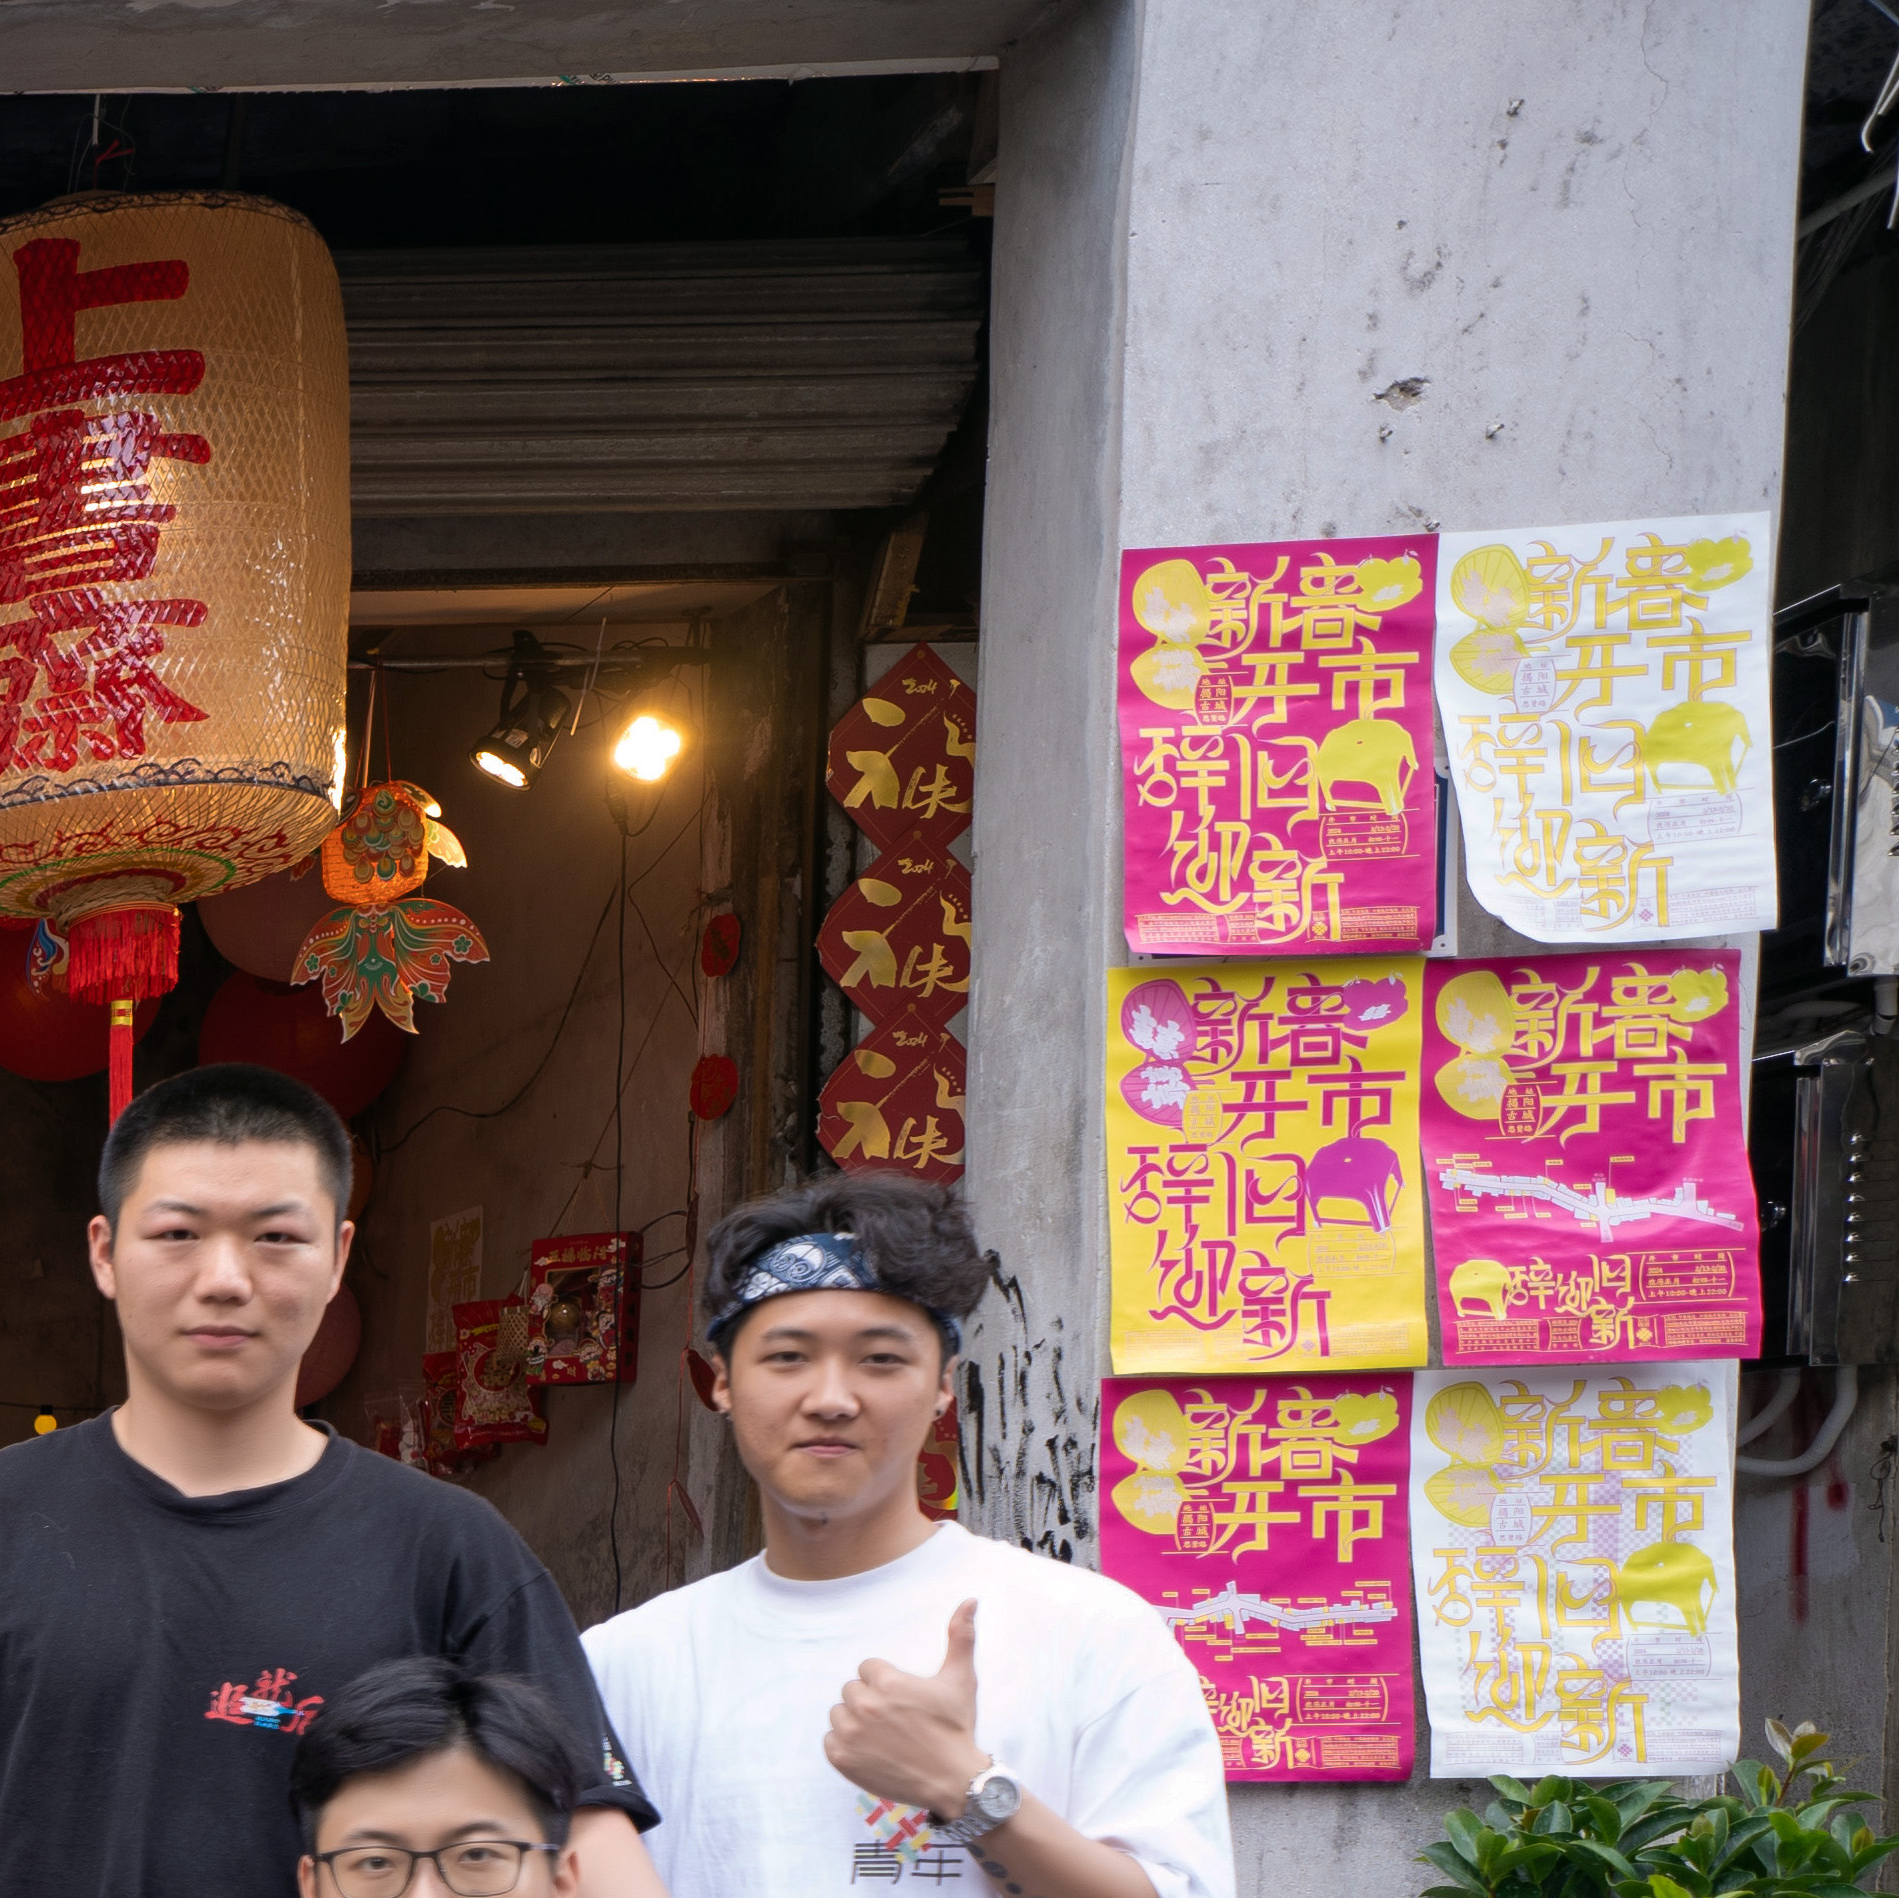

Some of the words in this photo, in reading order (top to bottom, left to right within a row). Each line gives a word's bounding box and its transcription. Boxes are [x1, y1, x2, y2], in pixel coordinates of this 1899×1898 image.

[1204, 552, 1383, 661] 新春
[1524, 533, 1709, 644] 新春
[1199, 699, 1228, 711] 古城
[1221, 636, 1419, 737] 开市
[1542, 615, 1752, 721] 开市
[1192, 972, 1368, 1078] 新春
[1509, 963, 1693, 1071] 新春
[1209, 1054, 1405, 1154] 开市
[1506, 1110, 1535, 1121] 古城
[1522, 1046, 1727, 1149] 开市
[1183, 1386, 1359, 1488] 新春
[1500, 1376, 1679, 1480] 新春
[1182, 1526, 1209, 1536] 古城
[1196, 1468, 1397, 1566] 开市
[1515, 1459, 1716, 1558] 开市
